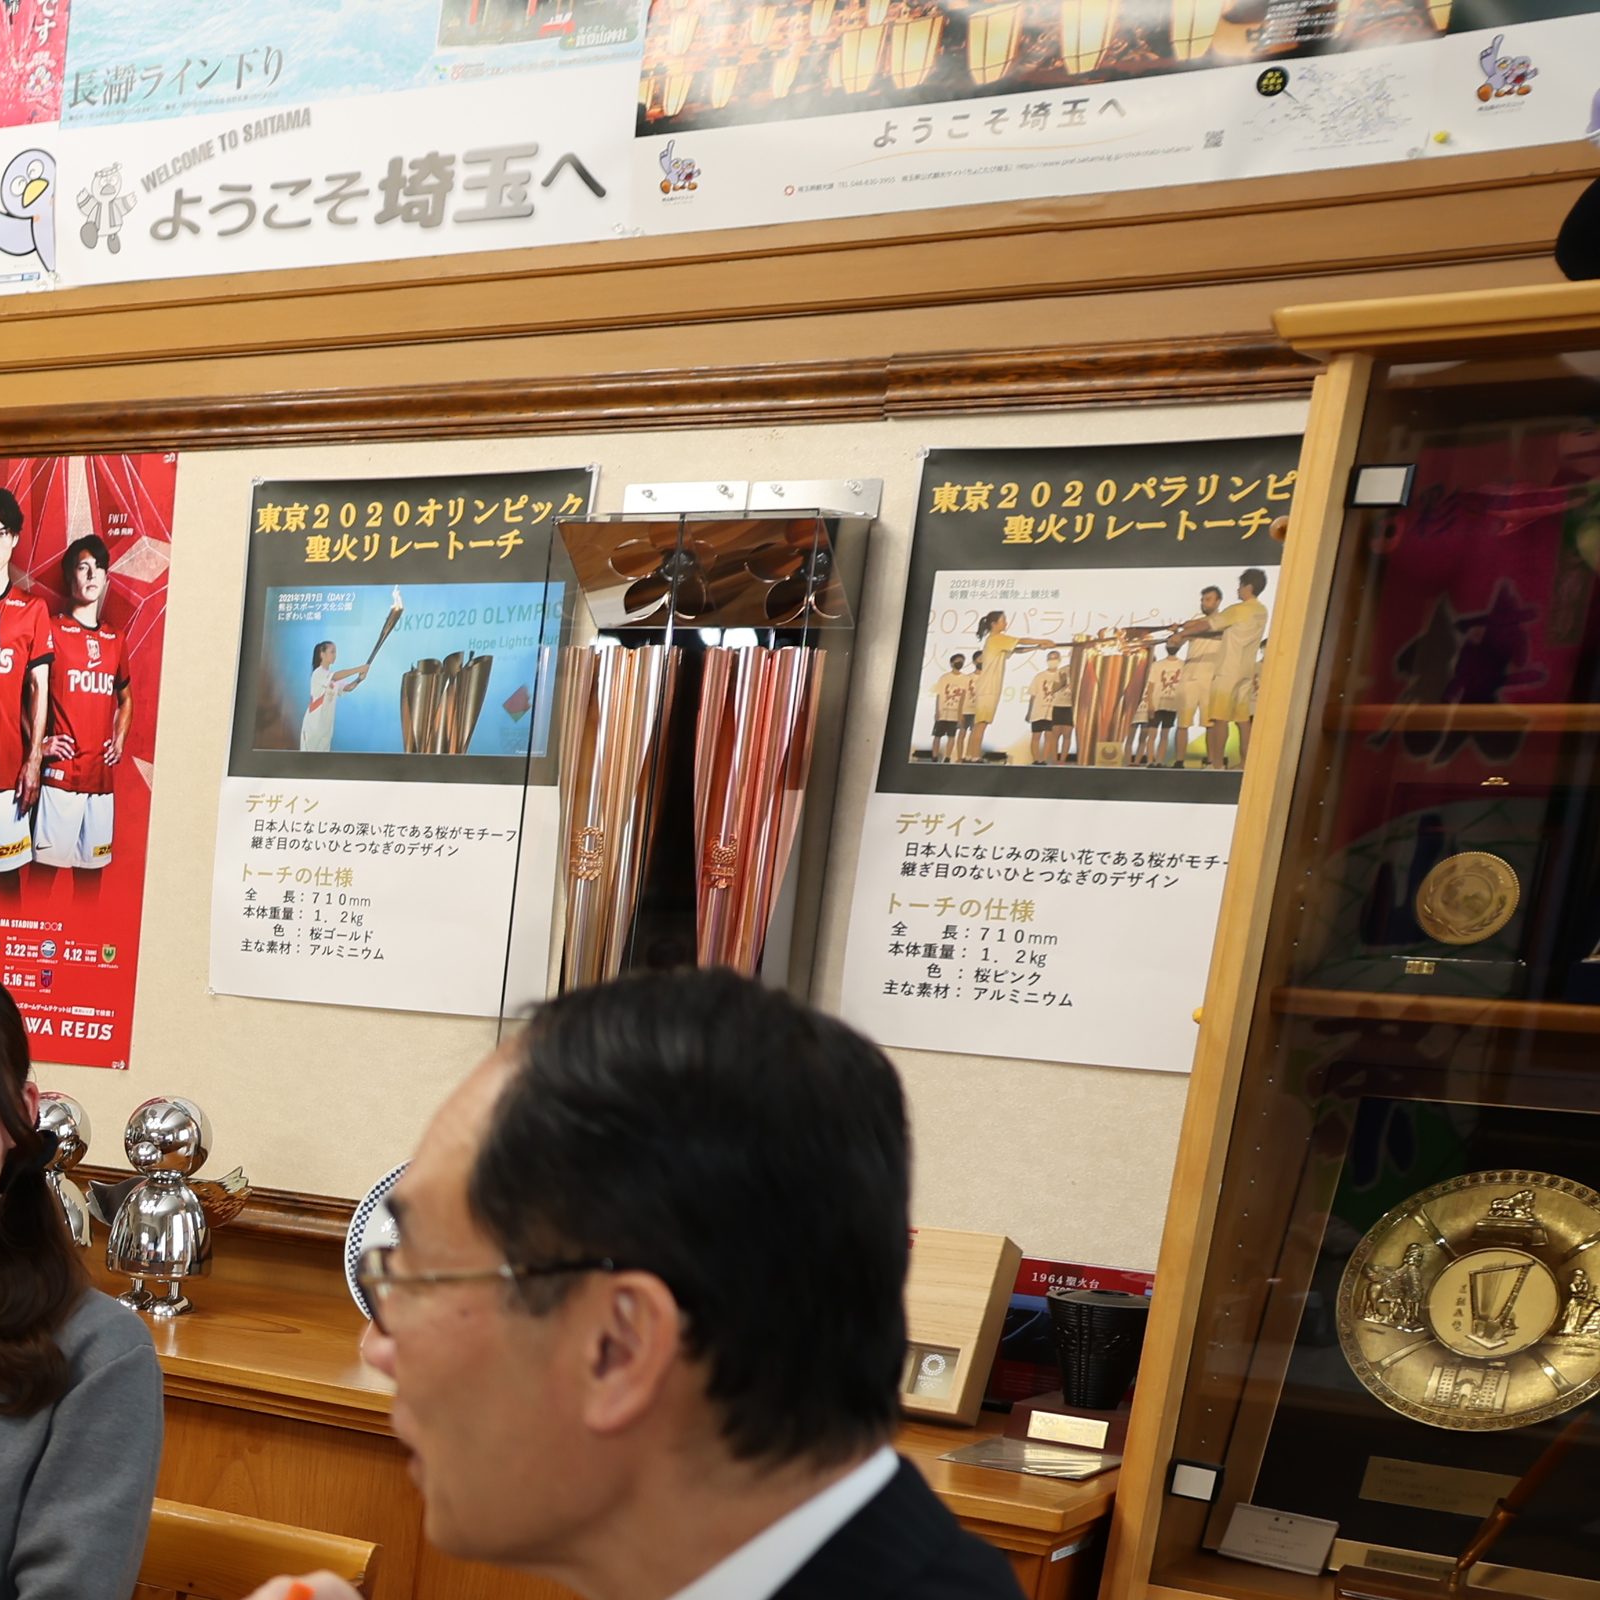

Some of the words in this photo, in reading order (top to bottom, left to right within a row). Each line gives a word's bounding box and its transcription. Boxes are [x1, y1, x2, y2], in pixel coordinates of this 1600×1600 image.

[873, 97, 1128, 149] ようこそ埼玉へ
[140, 139, 216, 193] WELCOME
[217, 130, 239, 154] TO
[242, 107, 312, 144] SAITAMA
[150, 142, 608, 242] ようこそ埼玉へ
[1002, 508, 1273, 545] 聖火リレートーチ
[305, 529, 524, 563] 聖火リレートーチ
[950, 579, 1015, 589] 2021年8月19日
[277, 610, 322, 621] にぎわい広場
[393, 613, 434, 632] OKYO
[437, 611, 476, 629] 2020
[468, 637, 497, 652] Hope
[499, 635, 534, 651] Lights
[67, 669, 114, 695] POLUS
[245, 793, 320, 815] デザイン
[253, 818, 518, 843] 日本人になじみの深い花である桜がモチーフ
[895, 811, 995, 838] デザイン
[250, 835, 460, 858] 継ぎ目のないひとつなぎのデザイン
[241, 863, 354, 889] トーチの仕様
[900, 860, 1180, 890] 継ぎ目のないひとつなぎのデザイン
[888, 893, 1036, 924] トーチの仕様
[11, 919, 39, 929] STADIUM
[5, 944, 25, 957] 3.22
[63, 948, 82, 961] 4.12
[3, 973, 22, 986] 5.16
[61, 1020, 114, 1041] REDS
